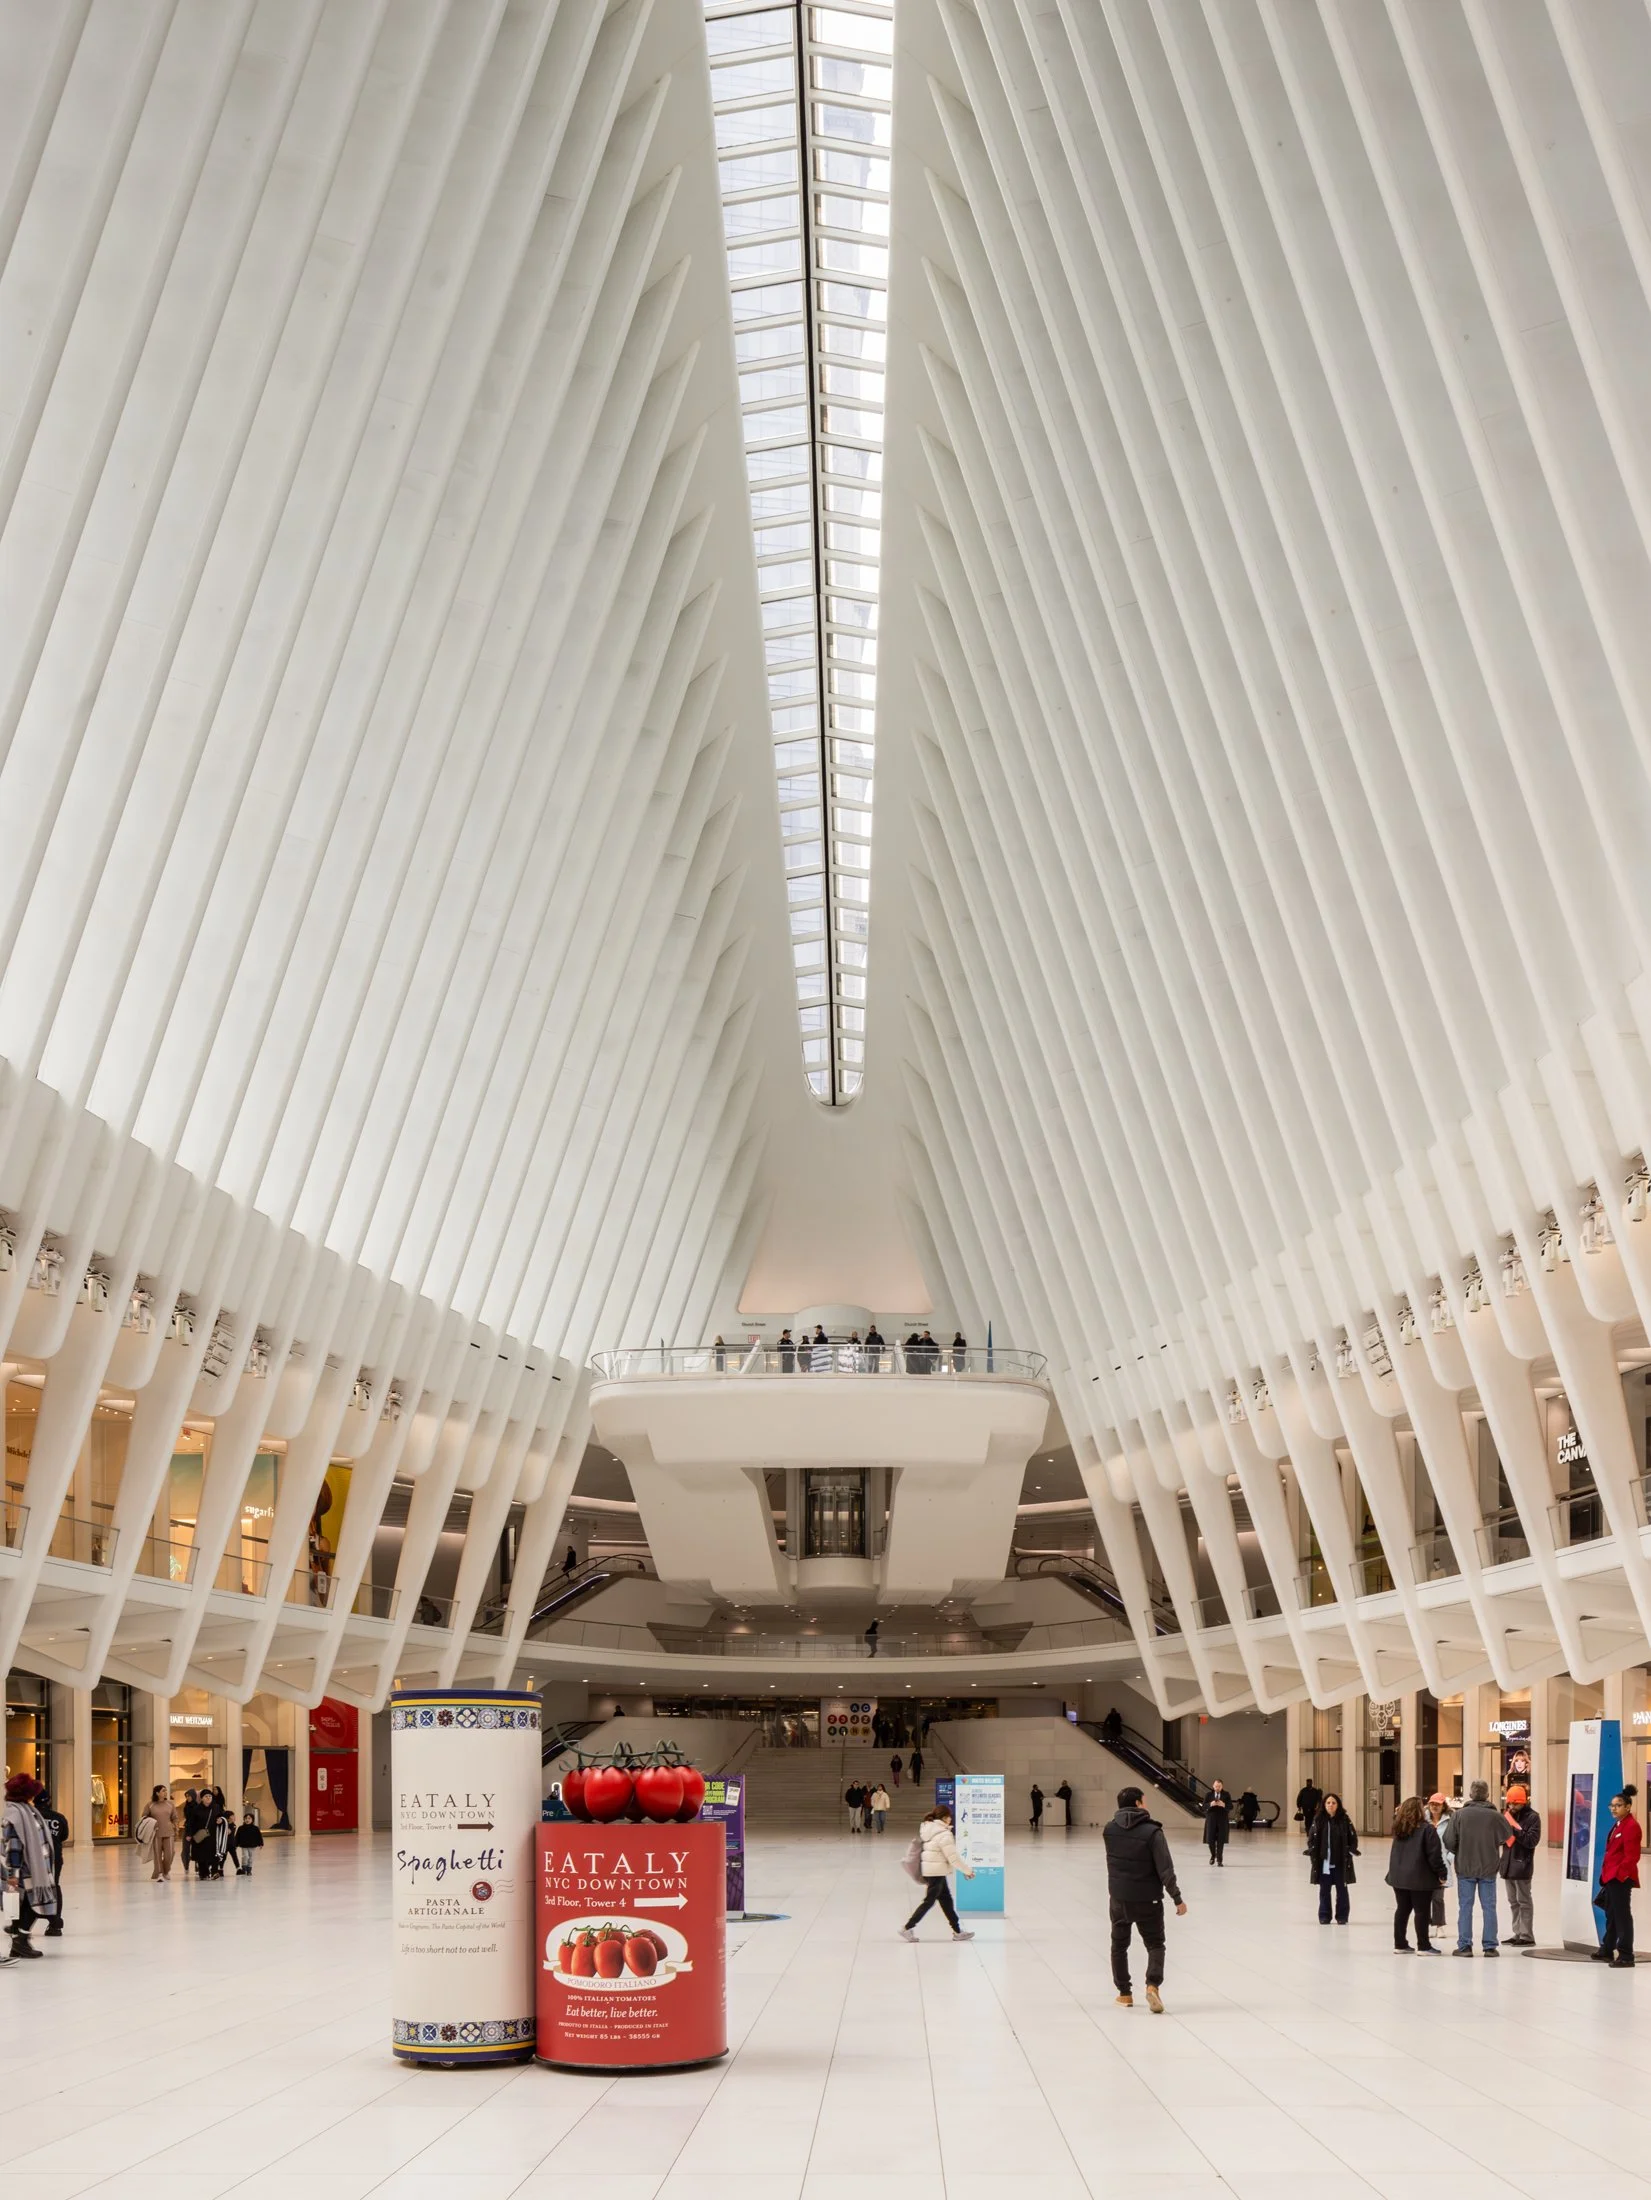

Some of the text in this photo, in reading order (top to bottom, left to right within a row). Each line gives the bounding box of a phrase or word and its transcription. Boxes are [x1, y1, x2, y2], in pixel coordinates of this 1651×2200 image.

[1557, 1432, 1577, 1450] THE
[1489, 1720, 1527, 1732] LONGINES
[400, 1793, 496, 1808] EATALY
[400, 1811, 495, 1819] NYC DOWNTOWN
[397, 1848, 504, 1885] Spaghetti
[544, 1851, 690, 1875] EATALY
[545, 1877, 688, 1890] NYC DOWNTOWN
[426, 1898, 460, 1906] PASTA
[545, 1895, 556, 1906] 3rd
[584, 1897, 616, 1908] Tower
[619, 1897, 626, 1907] 4
[408, 1907, 485, 1916] ARTIGIANALE
[426, 1944, 444, 1954] short
[446, 1946, 458, 1954] not
[481, 1943, 498, 1953] well.
[567, 1977, 657, 1989] POMODORO ITALIANO
[566, 2004, 658, 2019] Eat better, live better.
